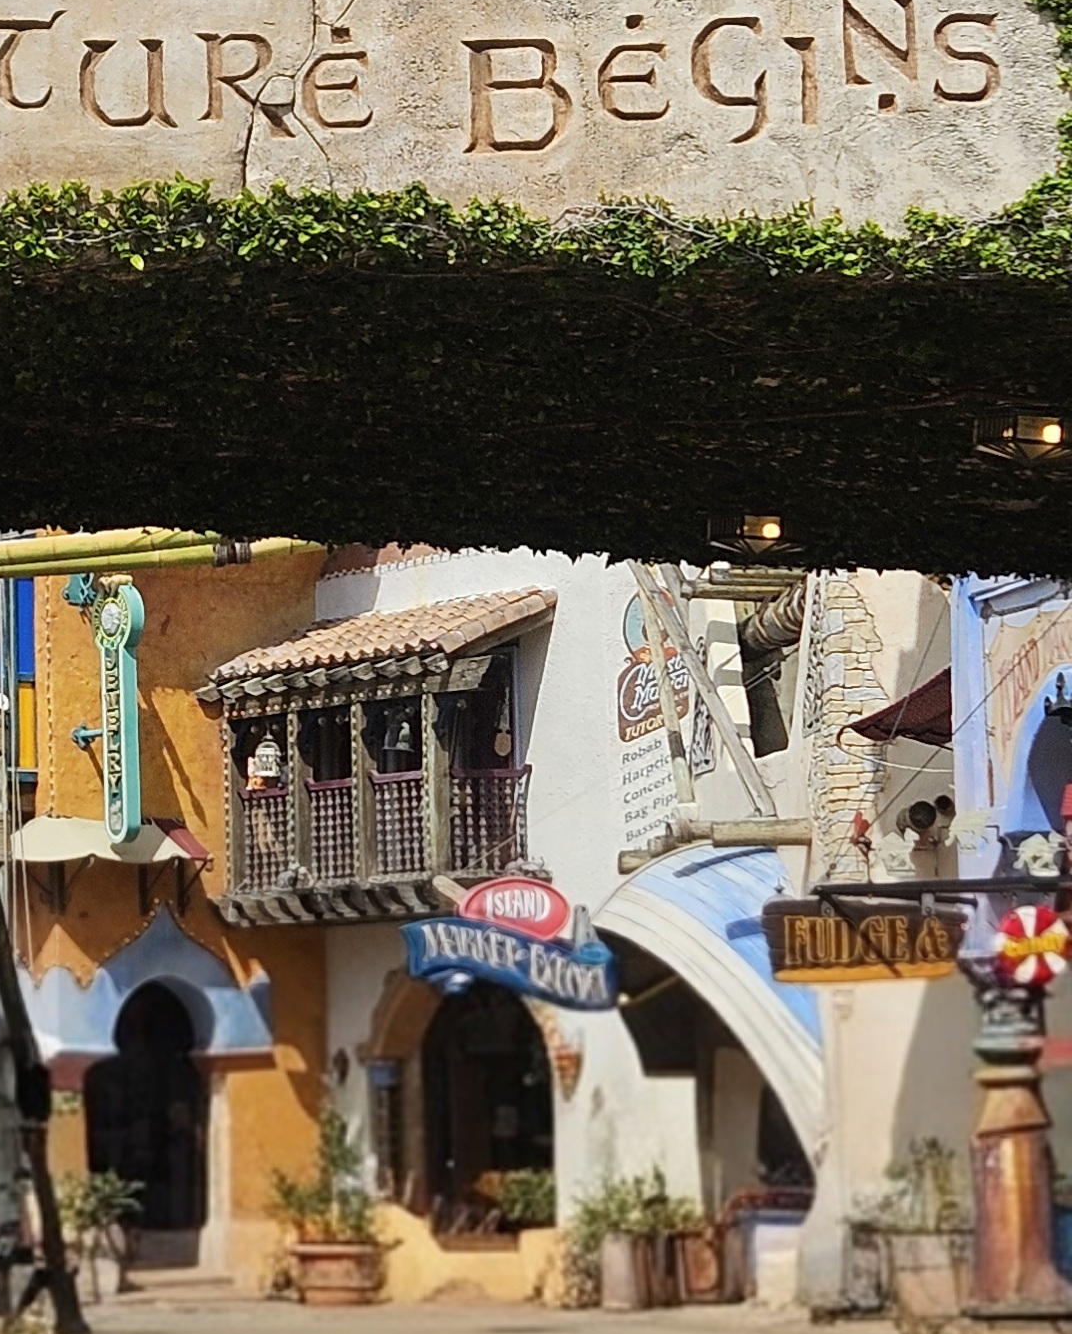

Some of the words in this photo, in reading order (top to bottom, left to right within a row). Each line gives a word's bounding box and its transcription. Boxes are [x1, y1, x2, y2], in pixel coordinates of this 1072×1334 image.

[622, 739, 662, 765] Robab
[623, 773, 673, 804] Concert
[624, 806, 649, 823] Bag
[484, 887, 551, 922] ISLAND
[421, 922, 518, 969] MARKET
[784, 915, 910, 965] FUDGE
[915, 916, 949, 962] &
